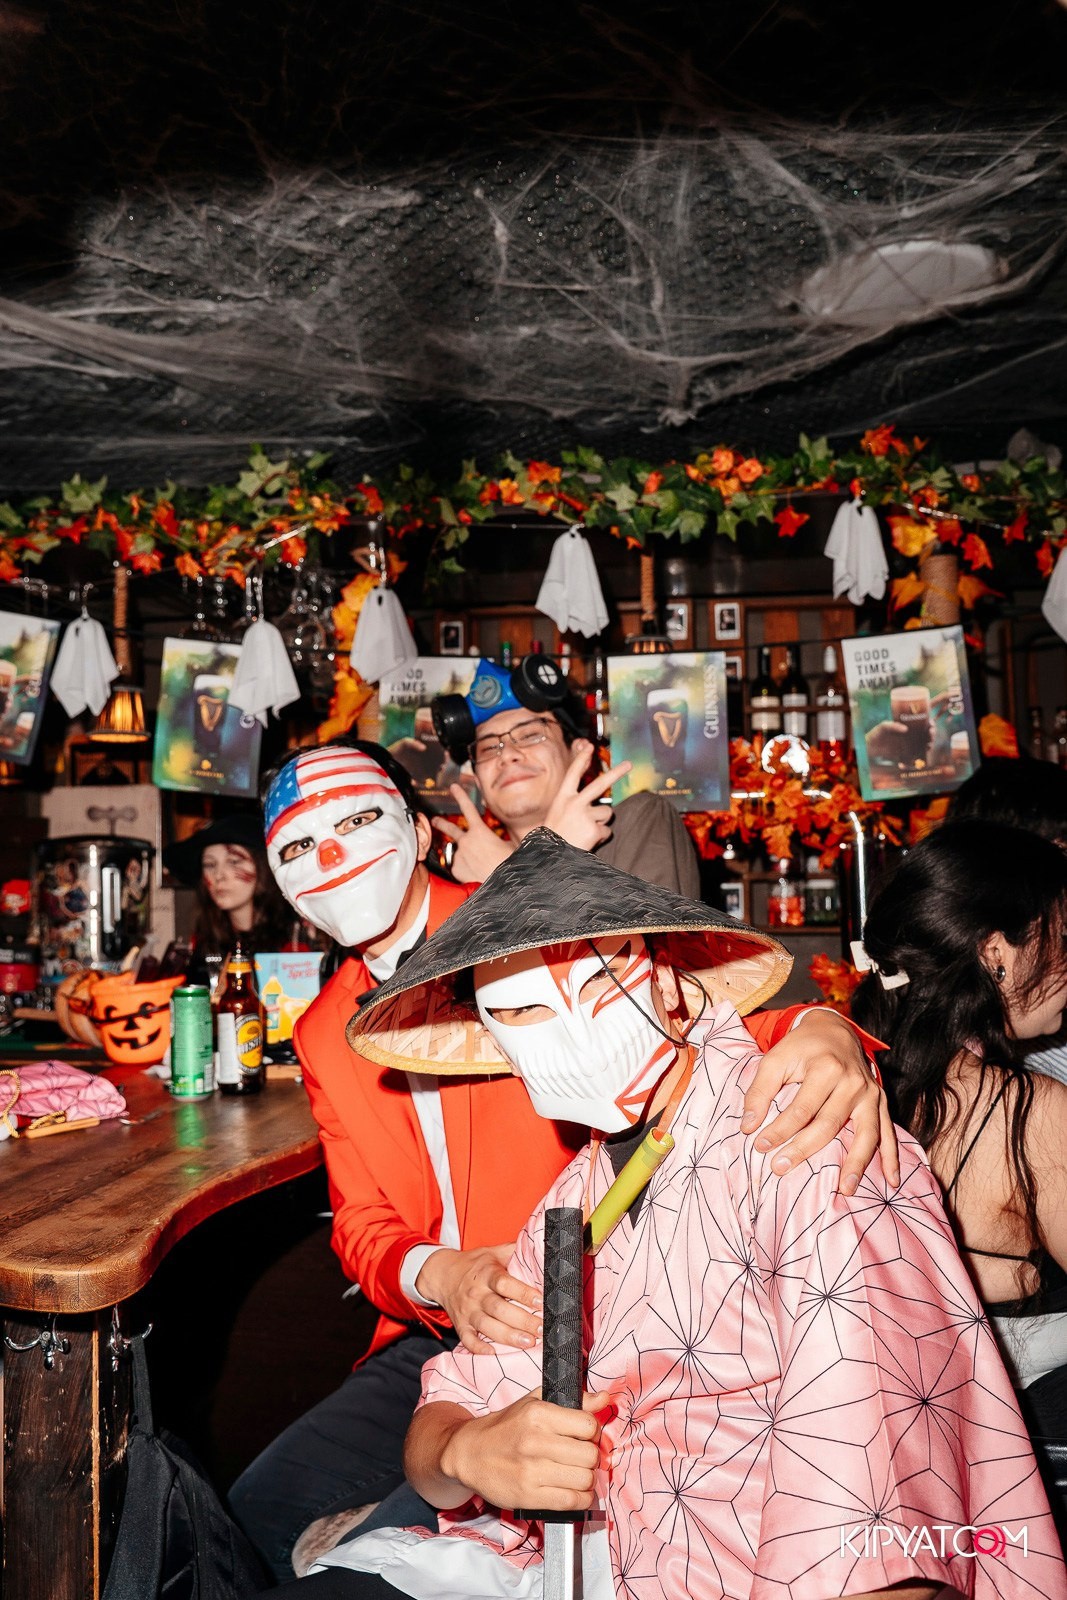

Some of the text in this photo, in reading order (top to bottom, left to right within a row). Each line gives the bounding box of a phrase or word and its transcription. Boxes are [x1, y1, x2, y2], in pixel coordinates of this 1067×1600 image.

[854, 648, 889, 662] GOOD
[857, 661, 897, 675] TIMES
[703, 663, 720, 739] GUINNESS
